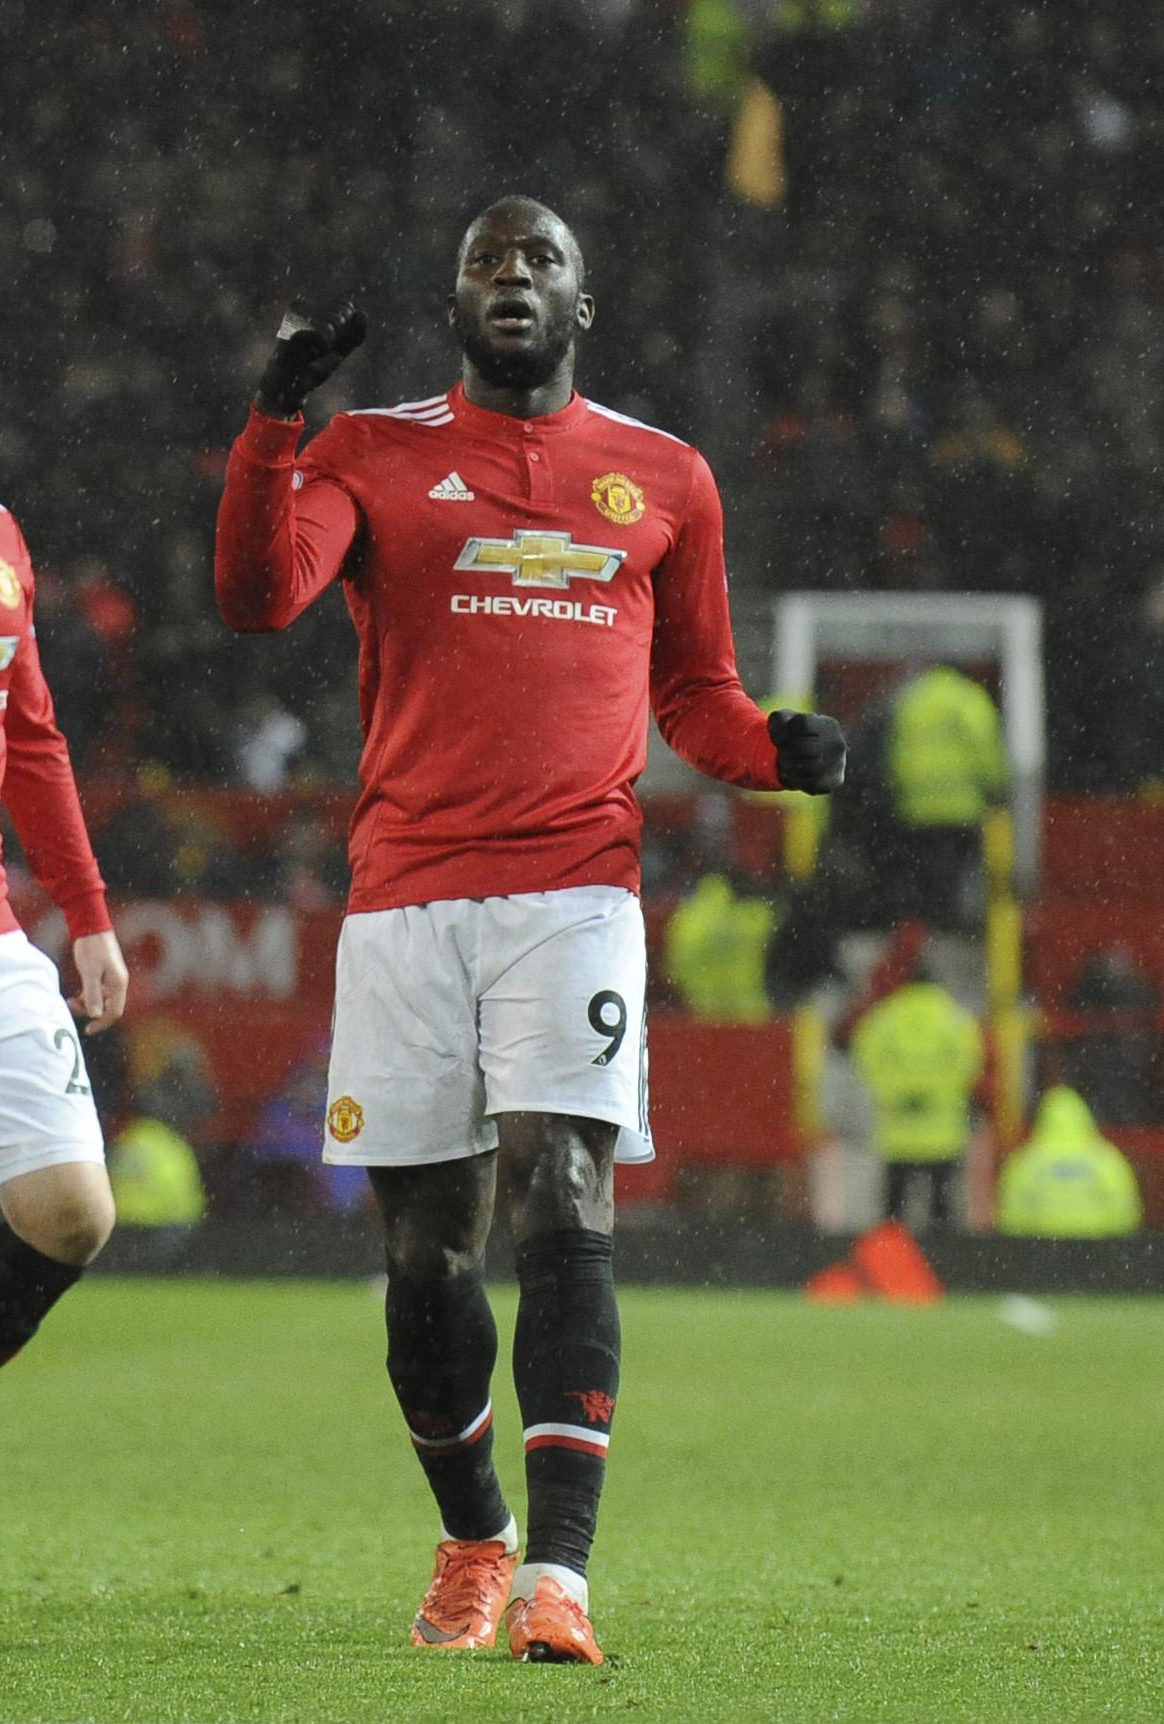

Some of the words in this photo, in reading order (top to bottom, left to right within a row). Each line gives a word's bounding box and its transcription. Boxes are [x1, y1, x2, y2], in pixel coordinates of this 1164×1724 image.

[427, 490, 475, 501] adidas
[450, 594, 618, 627] CHEVROLET
[588, 989, 627, 1067] 9
